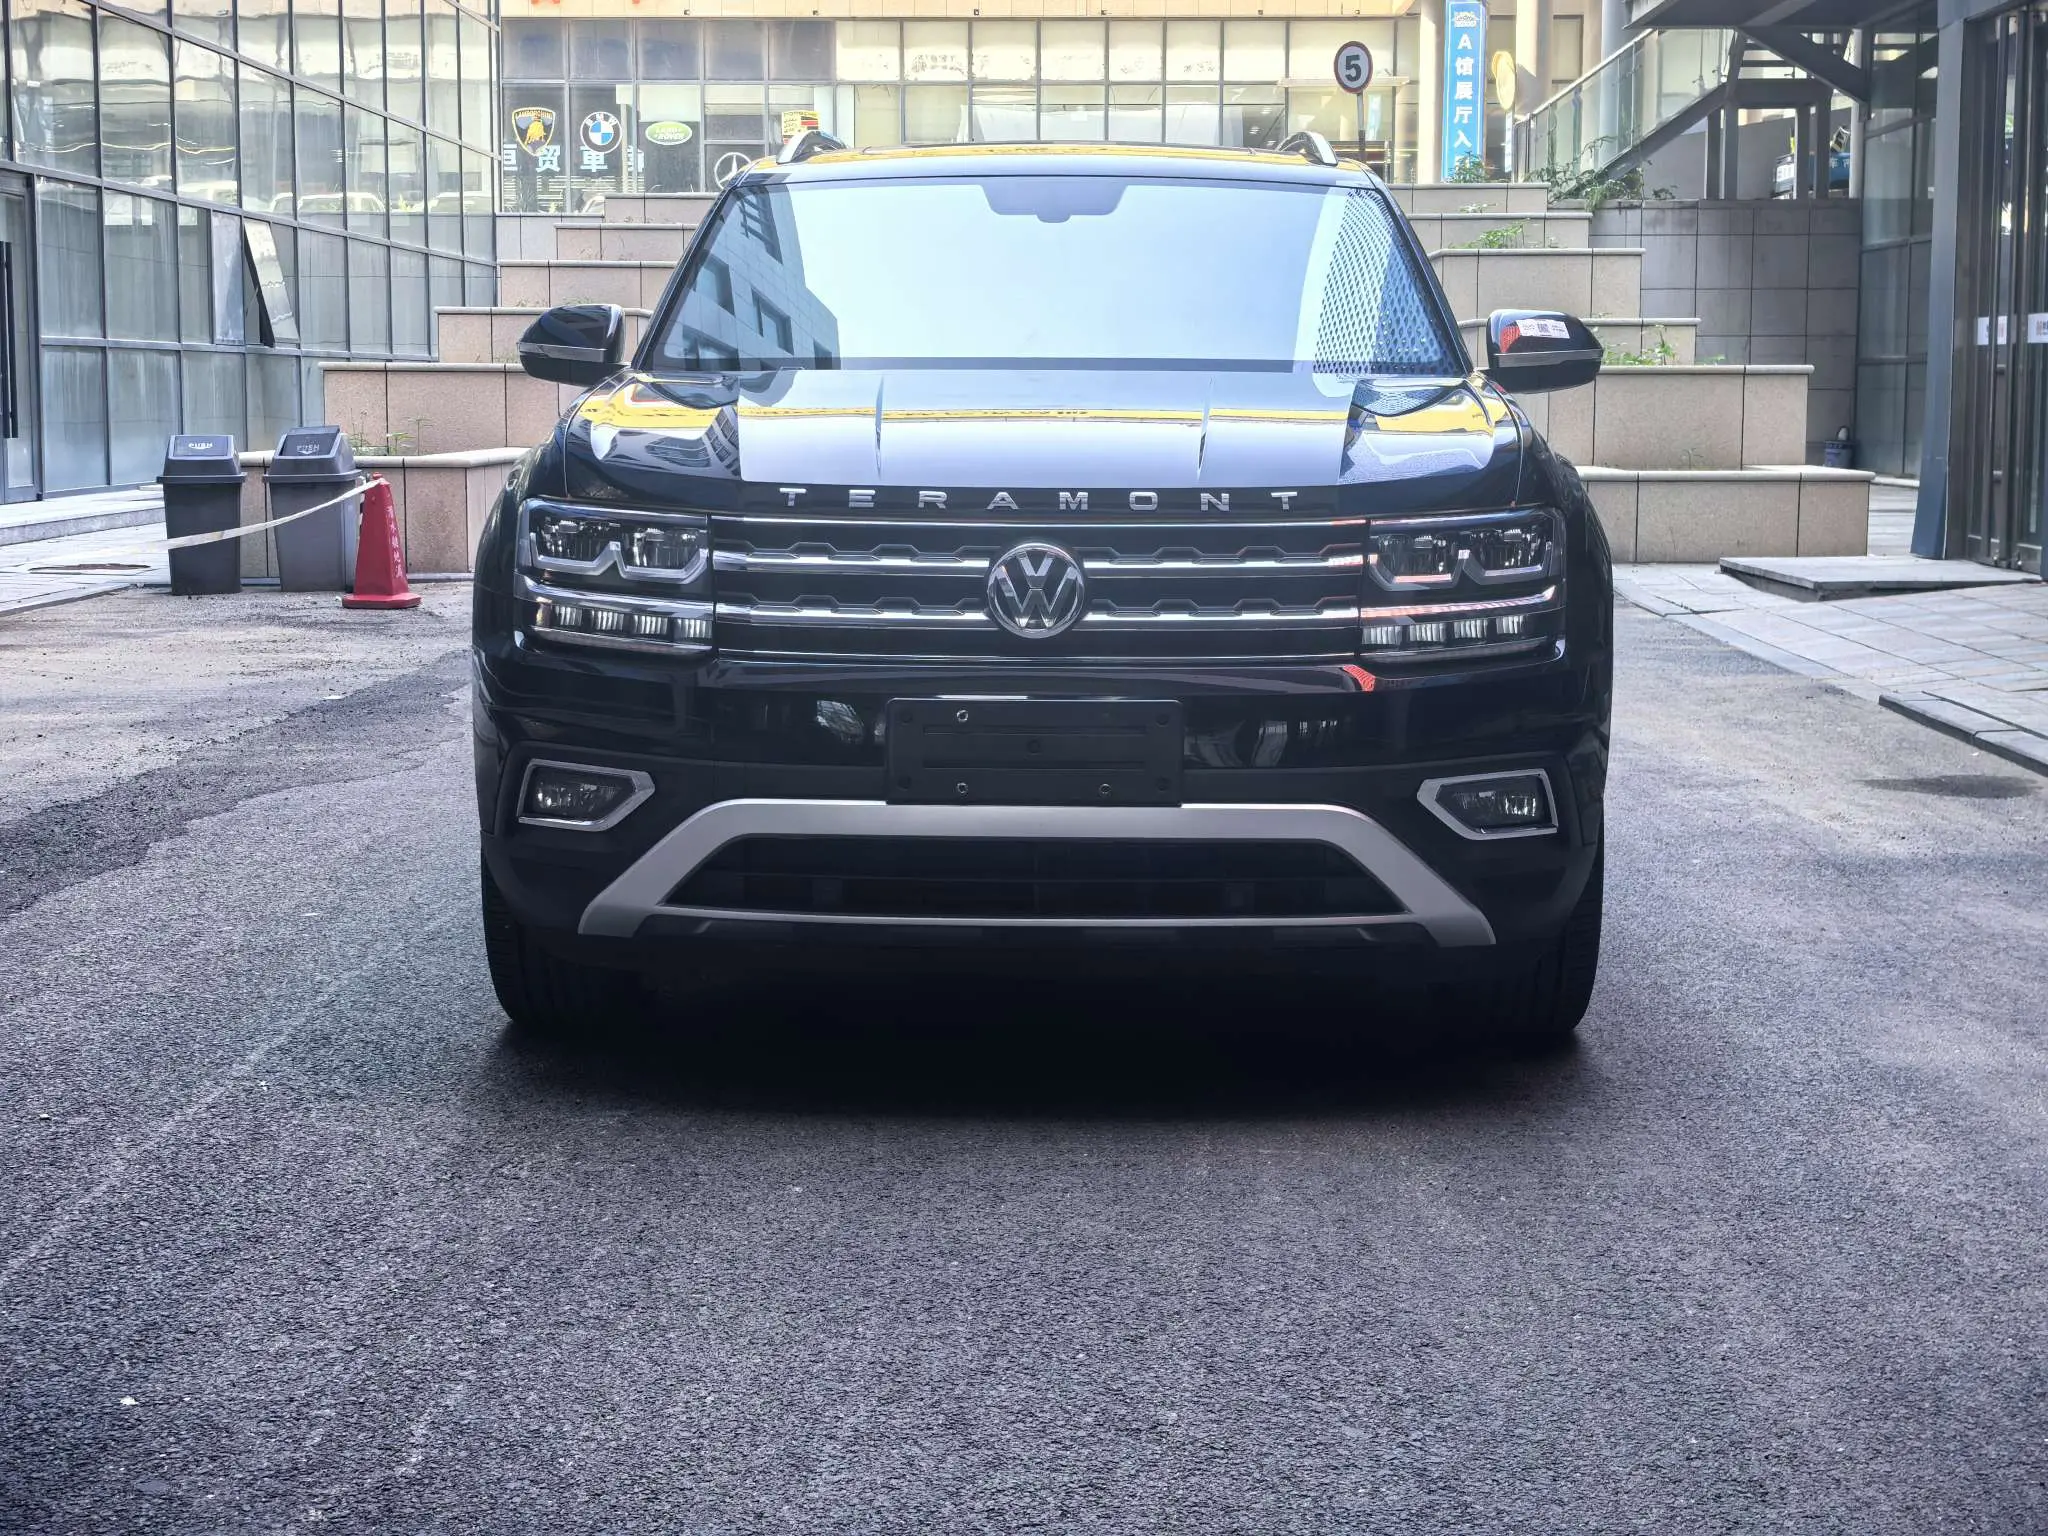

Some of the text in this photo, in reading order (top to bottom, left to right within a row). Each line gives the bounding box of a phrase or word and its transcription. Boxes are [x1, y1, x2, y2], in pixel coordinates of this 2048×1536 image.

[1344, 54, 1362, 82] 5
[585, 112, 617, 126] BMW
[778, 487, 1298, 512] TERAMONT
